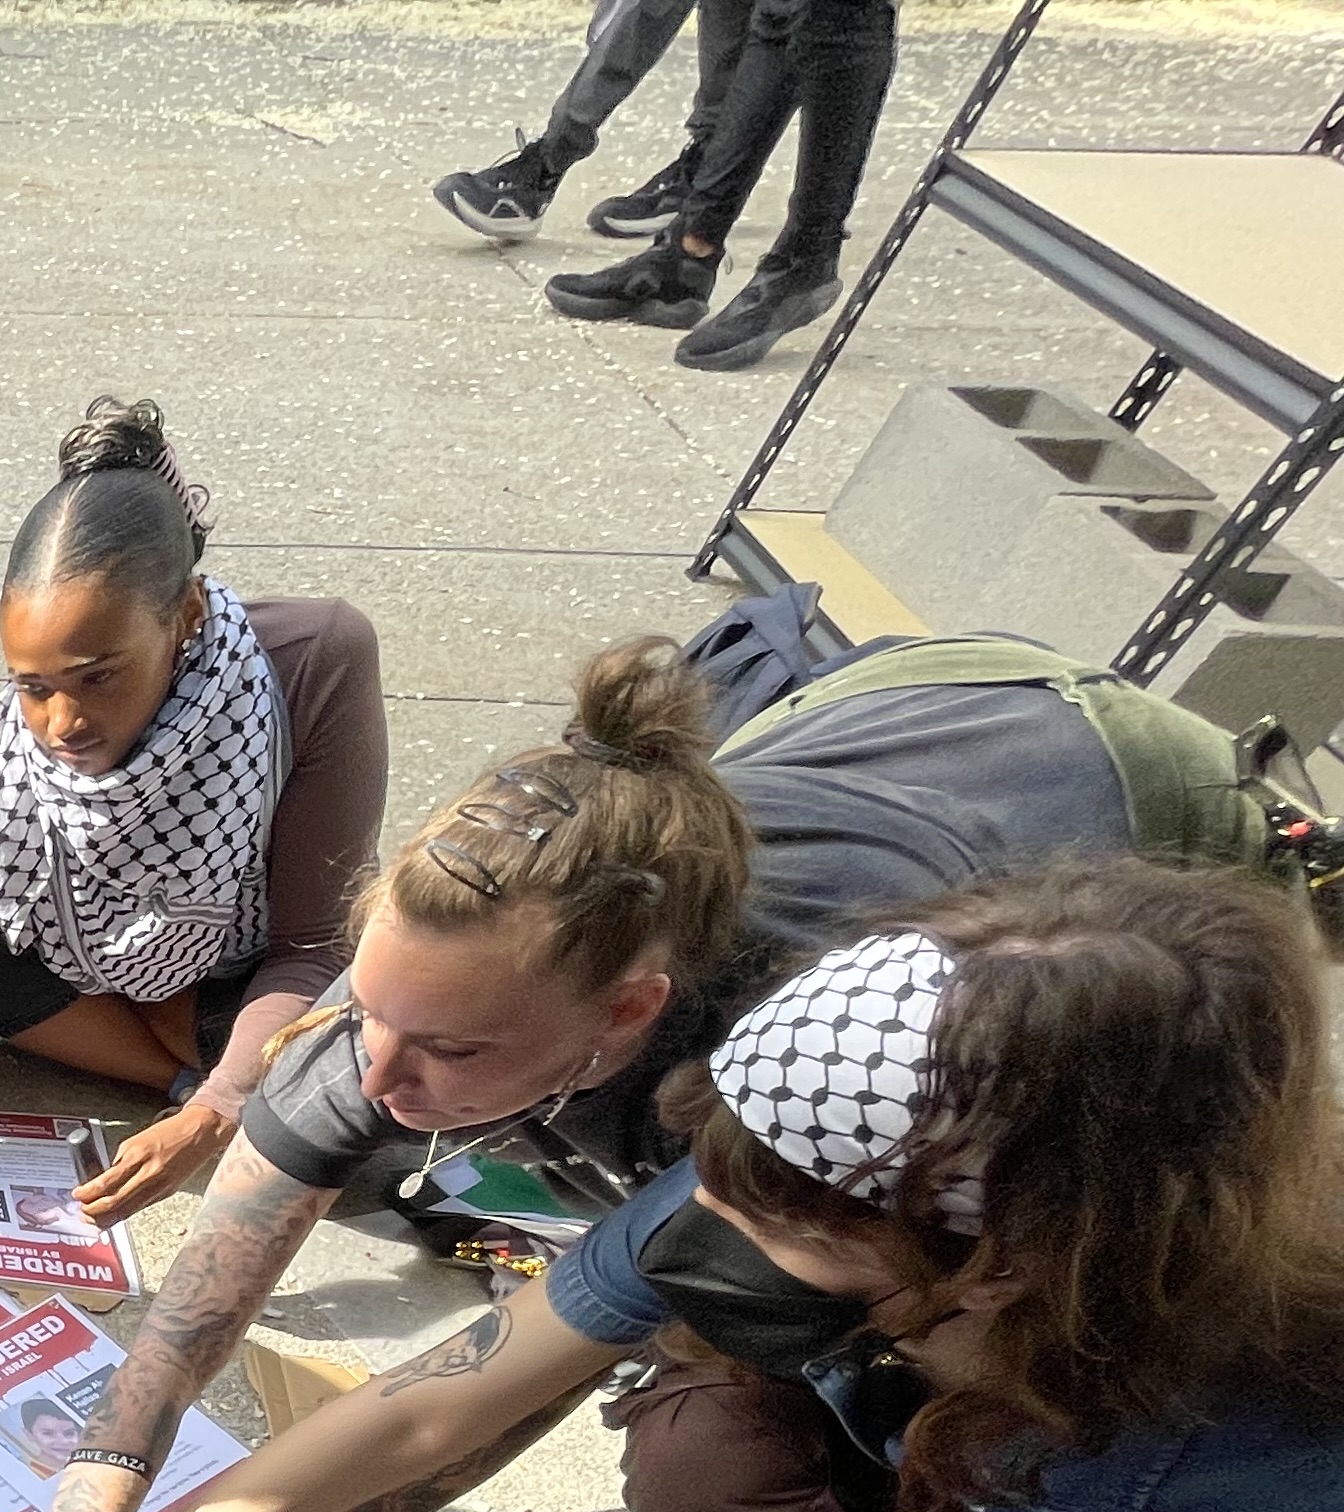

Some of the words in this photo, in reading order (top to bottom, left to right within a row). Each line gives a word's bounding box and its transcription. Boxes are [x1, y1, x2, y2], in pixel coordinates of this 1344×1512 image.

[42, 1250, 60, 1258] BY
[1, 1352, 42, 1376] ISRAEL
[73, 1449, 103, 1461] SAVE
[107, 1452, 146, 1472] GAZA
